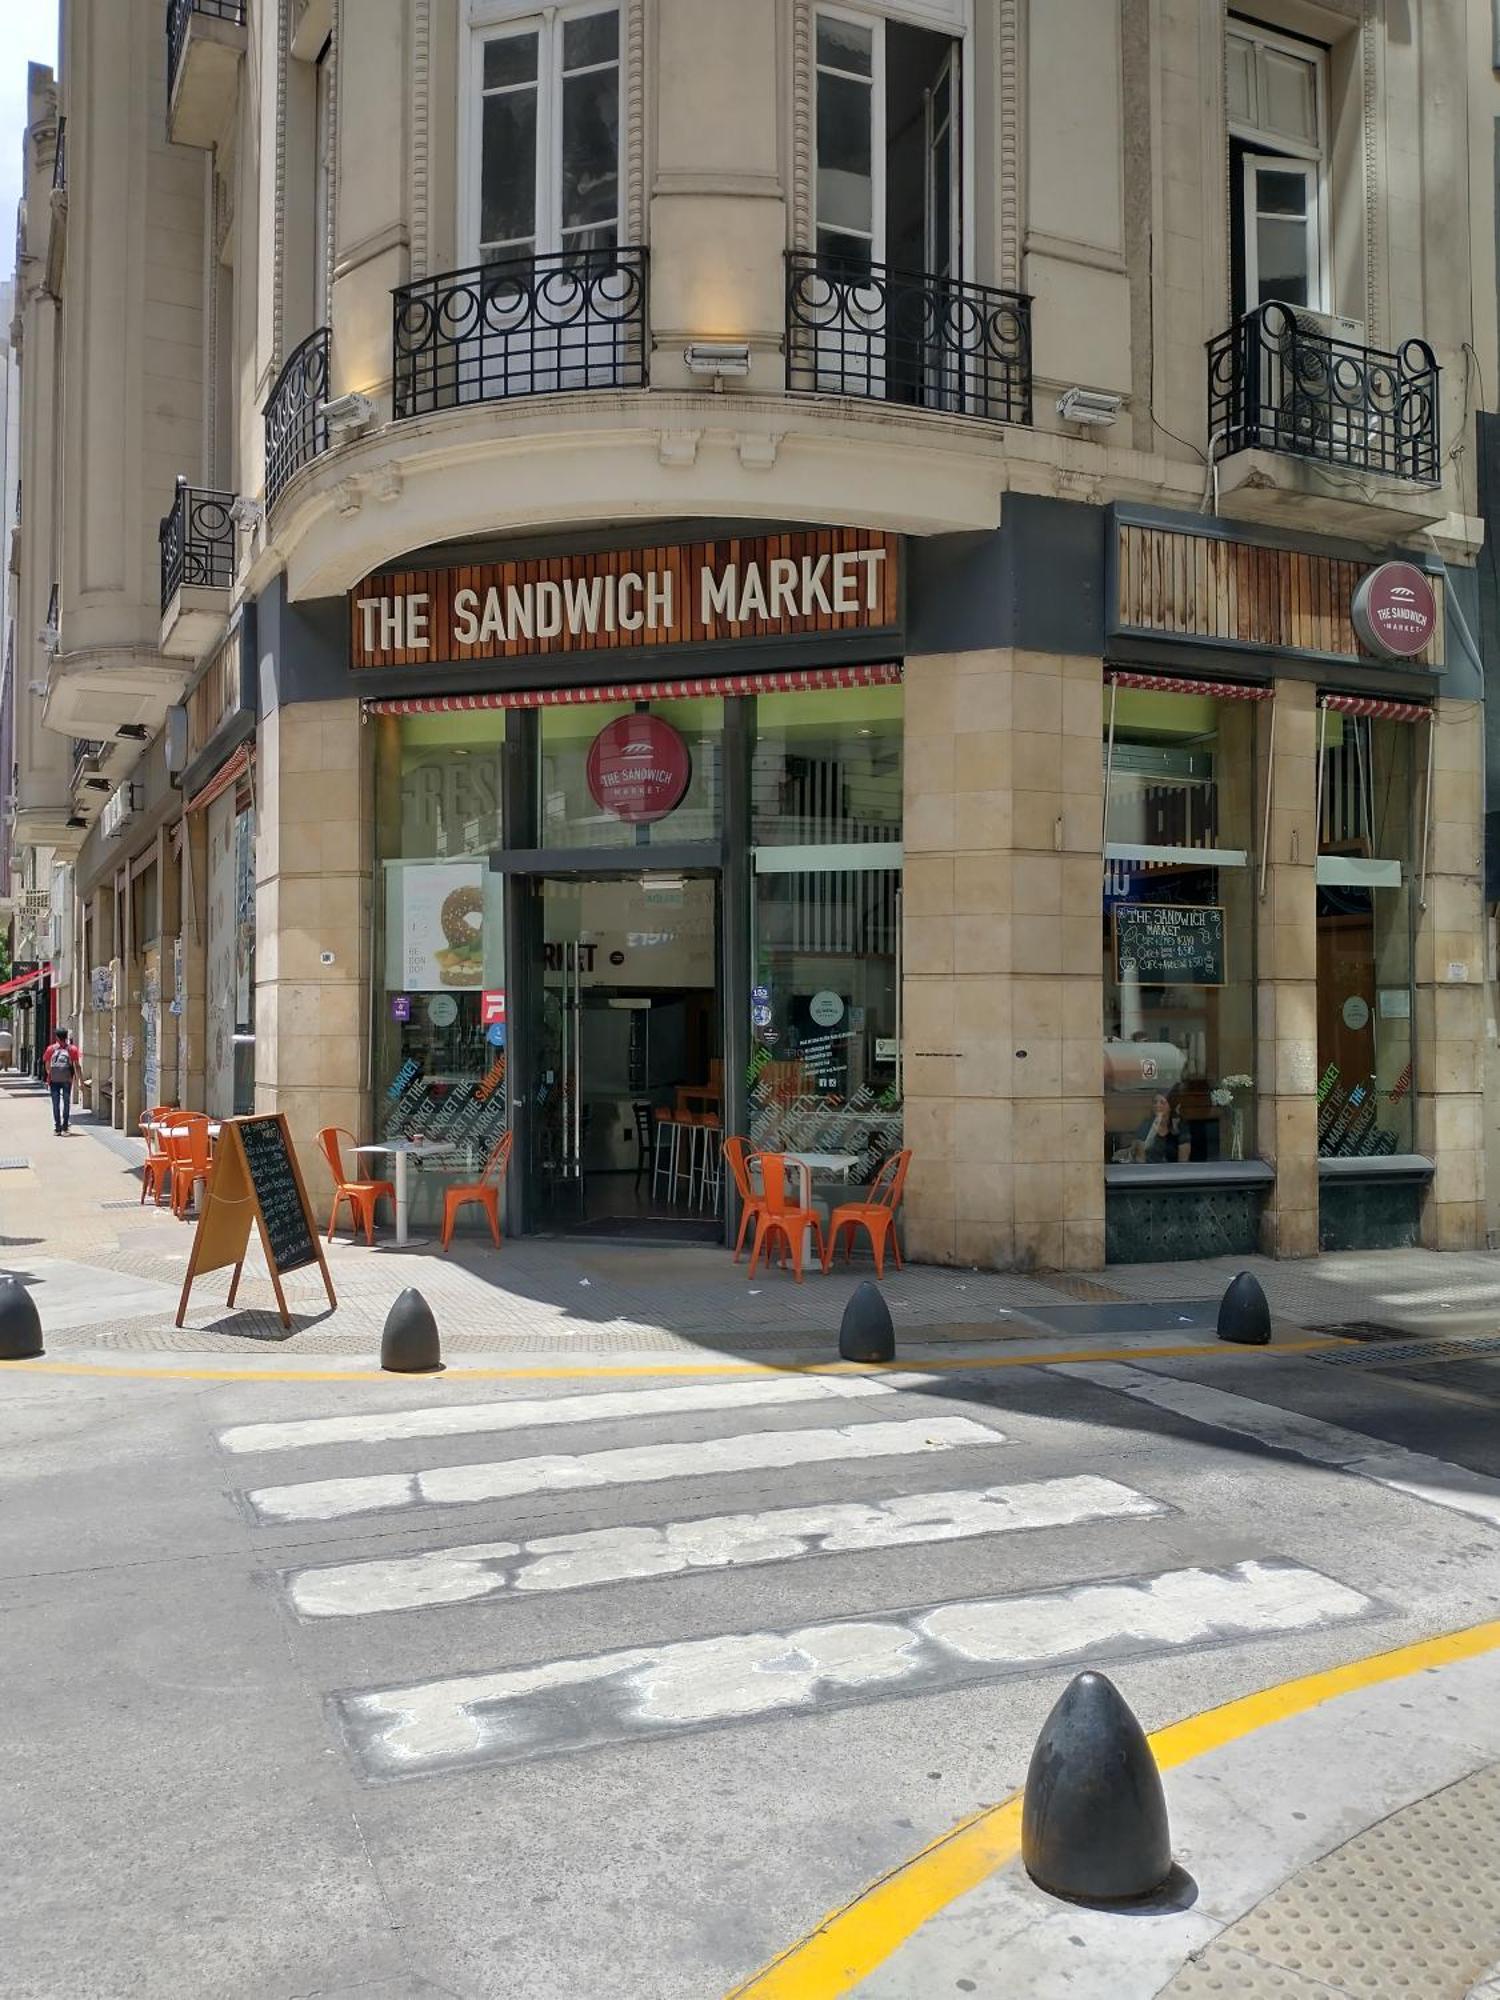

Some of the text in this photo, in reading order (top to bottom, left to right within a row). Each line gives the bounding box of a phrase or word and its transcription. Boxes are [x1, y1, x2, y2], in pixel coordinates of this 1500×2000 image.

[356, 548, 887, 651] THE SANDWICH MARKET
[1377, 607, 1427, 626] THE SANDWICH
[601, 768, 673, 788] THE SANDWICH
[1127, 908, 1206, 926] THE SANDWICH
[1146, 924, 1180, 936] MARKET
[407, 1078, 426, 1102] THE
[851, 1083, 875, 1108] THE
[1349, 1083, 1367, 1108] THE
[403, 1096, 436, 1138] MARKET
[426, 1078, 473, 1139] MARKET THE
[462, 1097, 481, 1120] THE
